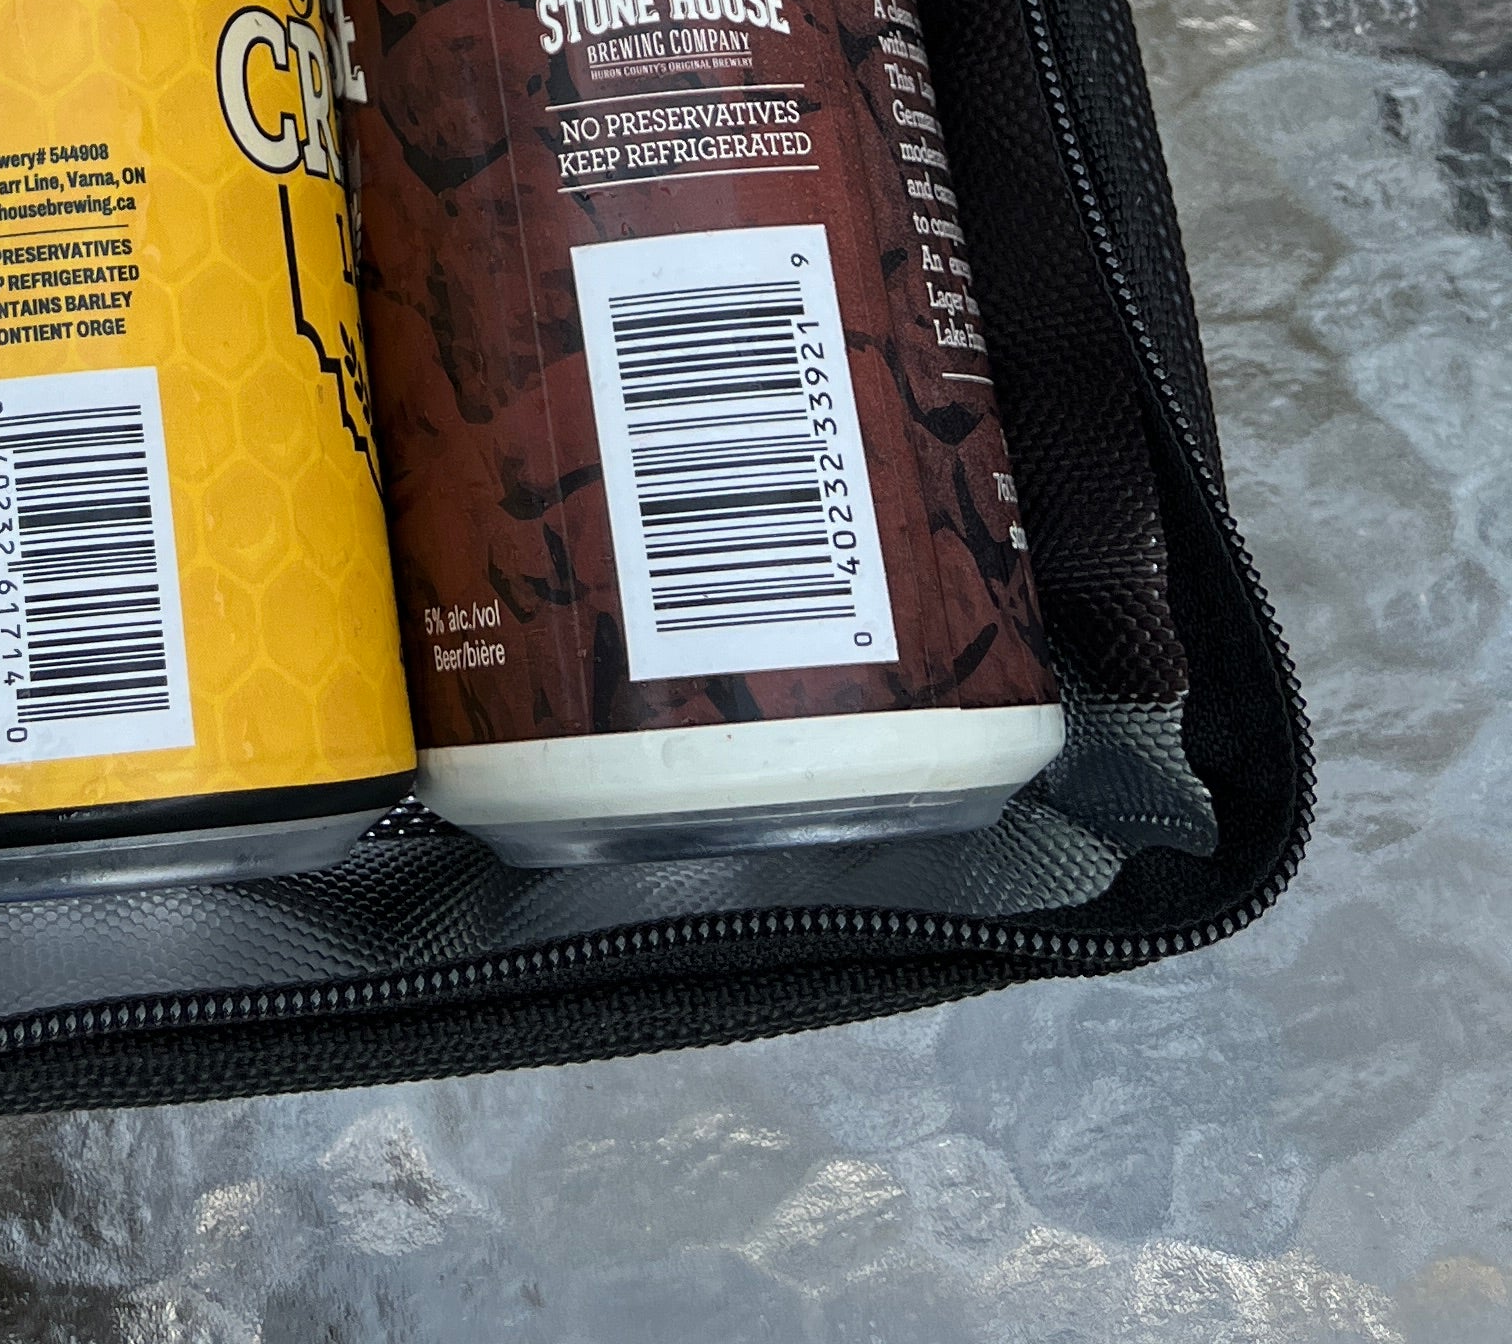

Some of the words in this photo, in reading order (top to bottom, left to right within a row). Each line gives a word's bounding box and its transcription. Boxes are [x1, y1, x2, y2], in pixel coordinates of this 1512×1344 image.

[586, 29, 666, 64] BREWING
[669, 28, 751, 55] COMPANY
[883, 62, 916, 94] This
[560, 115, 601, 145] NO
[604, 99, 801, 138] PRESERVATIVES
[49, 143, 110, 164] 544908
[558, 146, 621, 177] KEEP
[624, 131, 813, 169] REFRIGERATED
[24, 172, 65, 194] Line,
[66, 169, 120, 190] Varna,
[122, 166, 147, 185] ON
[906, 170, 935, 201] and
[912, 211, 930, 235] to
[790, 252, 810, 268] 9
[920, 244, 946, 273] An
[7, 264, 140, 292] REFRIGERATED
[64, 290, 133, 313] BARLEY
[76, 317, 127, 338] ORGE
[933, 317, 968, 349] Lake
[796, 320, 838, 438] 33921
[819, 452, 861, 576] 40232
[424, 605, 445, 636] 5%
[447, 597, 502, 633] alc./vol
[854, 631, 873, 647] 0
[433, 638, 506, 673] Beer/bière
[6, 726, 28, 744] 0
